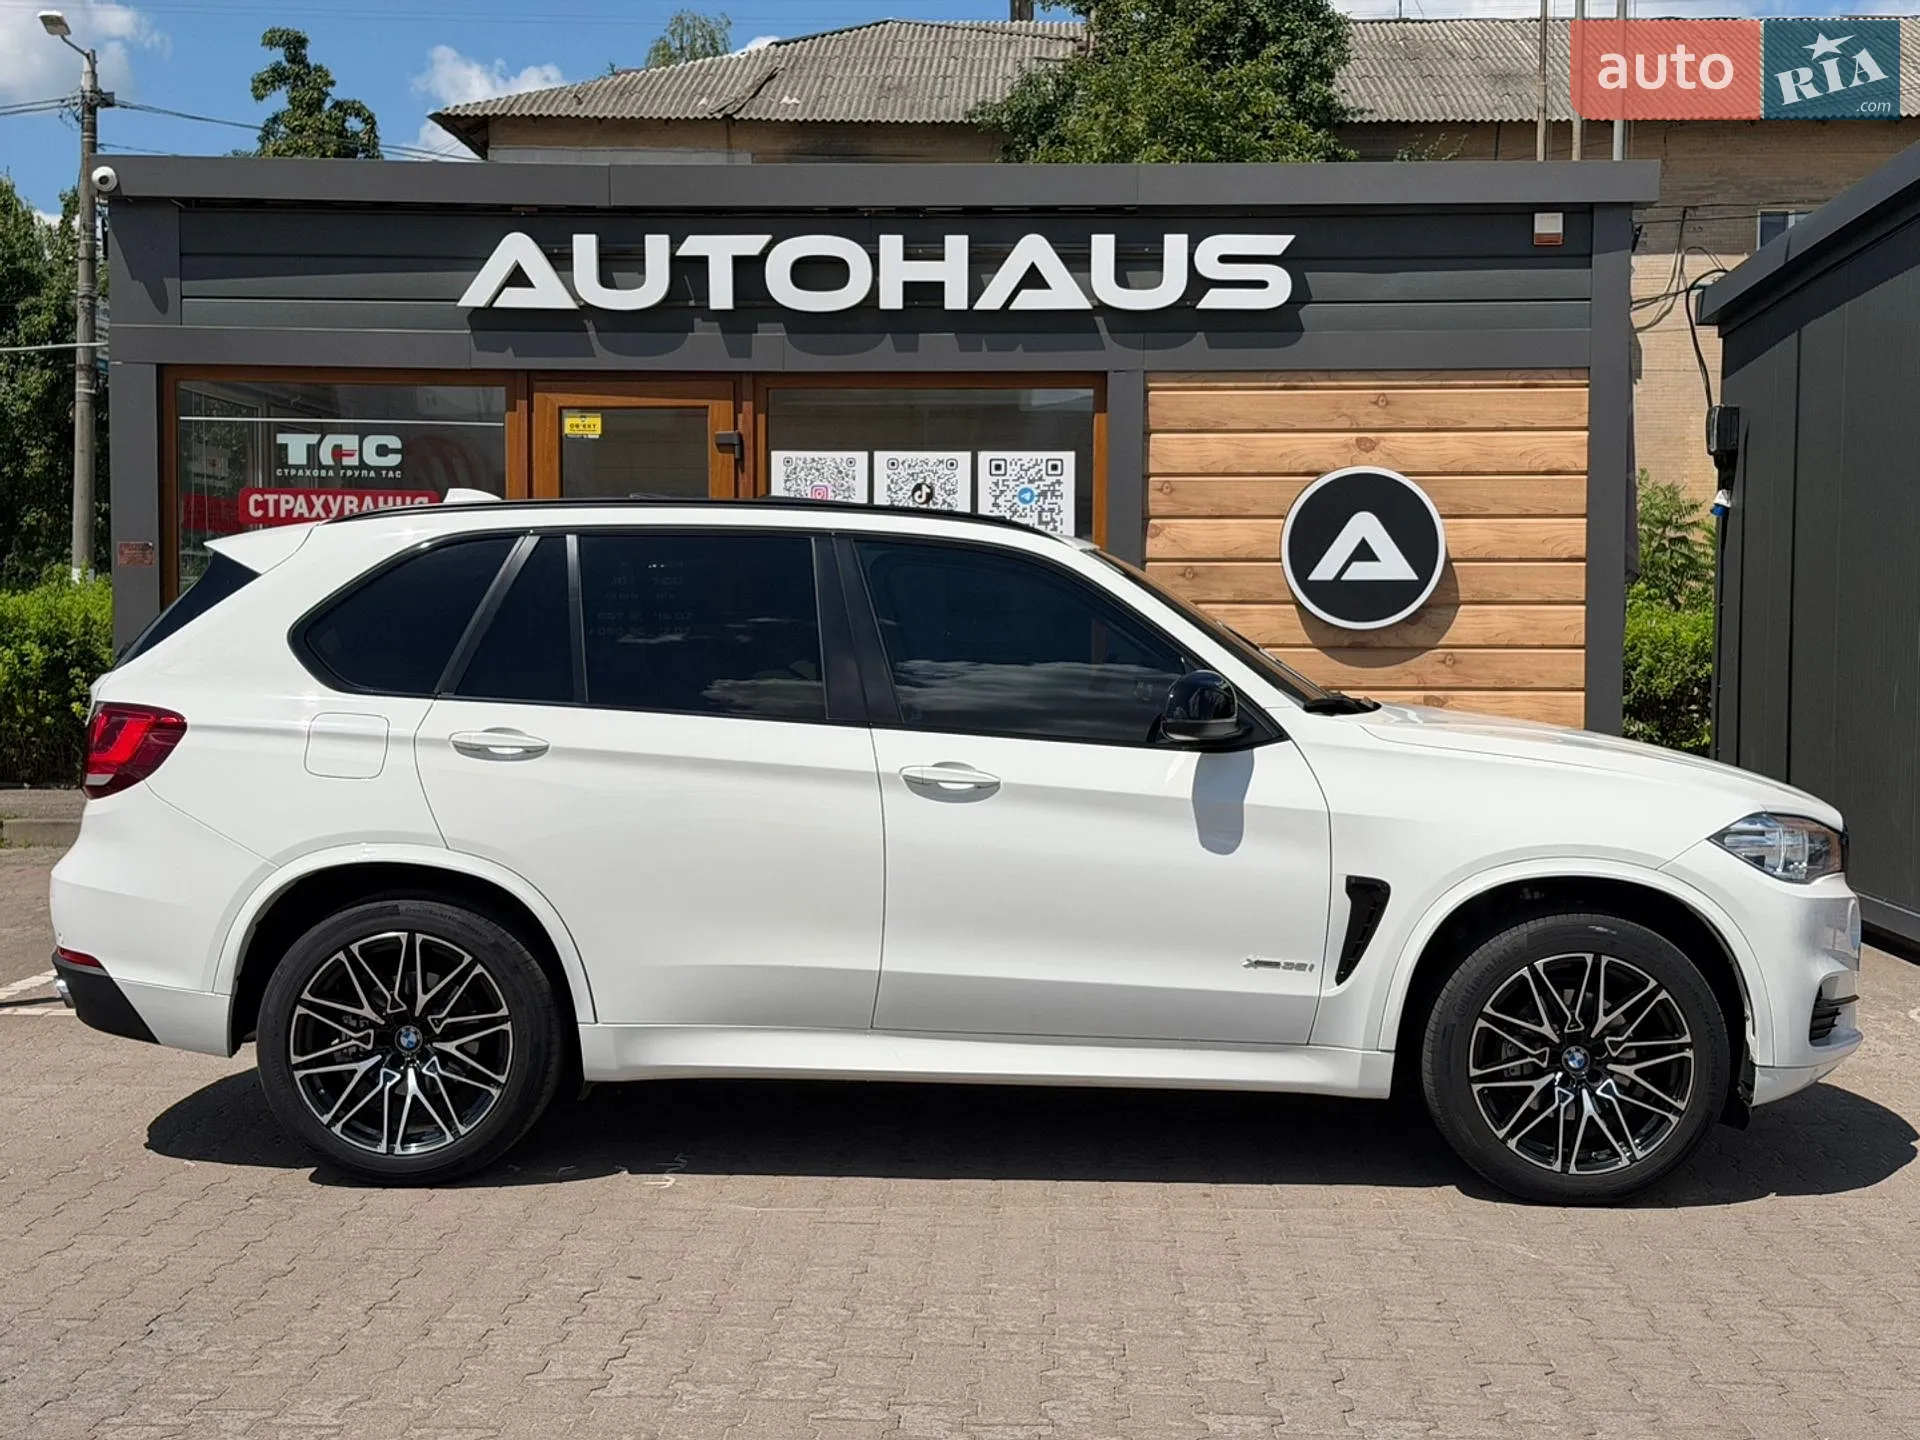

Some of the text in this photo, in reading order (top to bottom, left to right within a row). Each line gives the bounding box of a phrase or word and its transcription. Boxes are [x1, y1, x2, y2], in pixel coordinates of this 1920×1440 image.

[457, 231, 1297, 312] AUTOHAUS
[276, 468, 402, 478] СТРАХОВА ГРУПА ТАС
